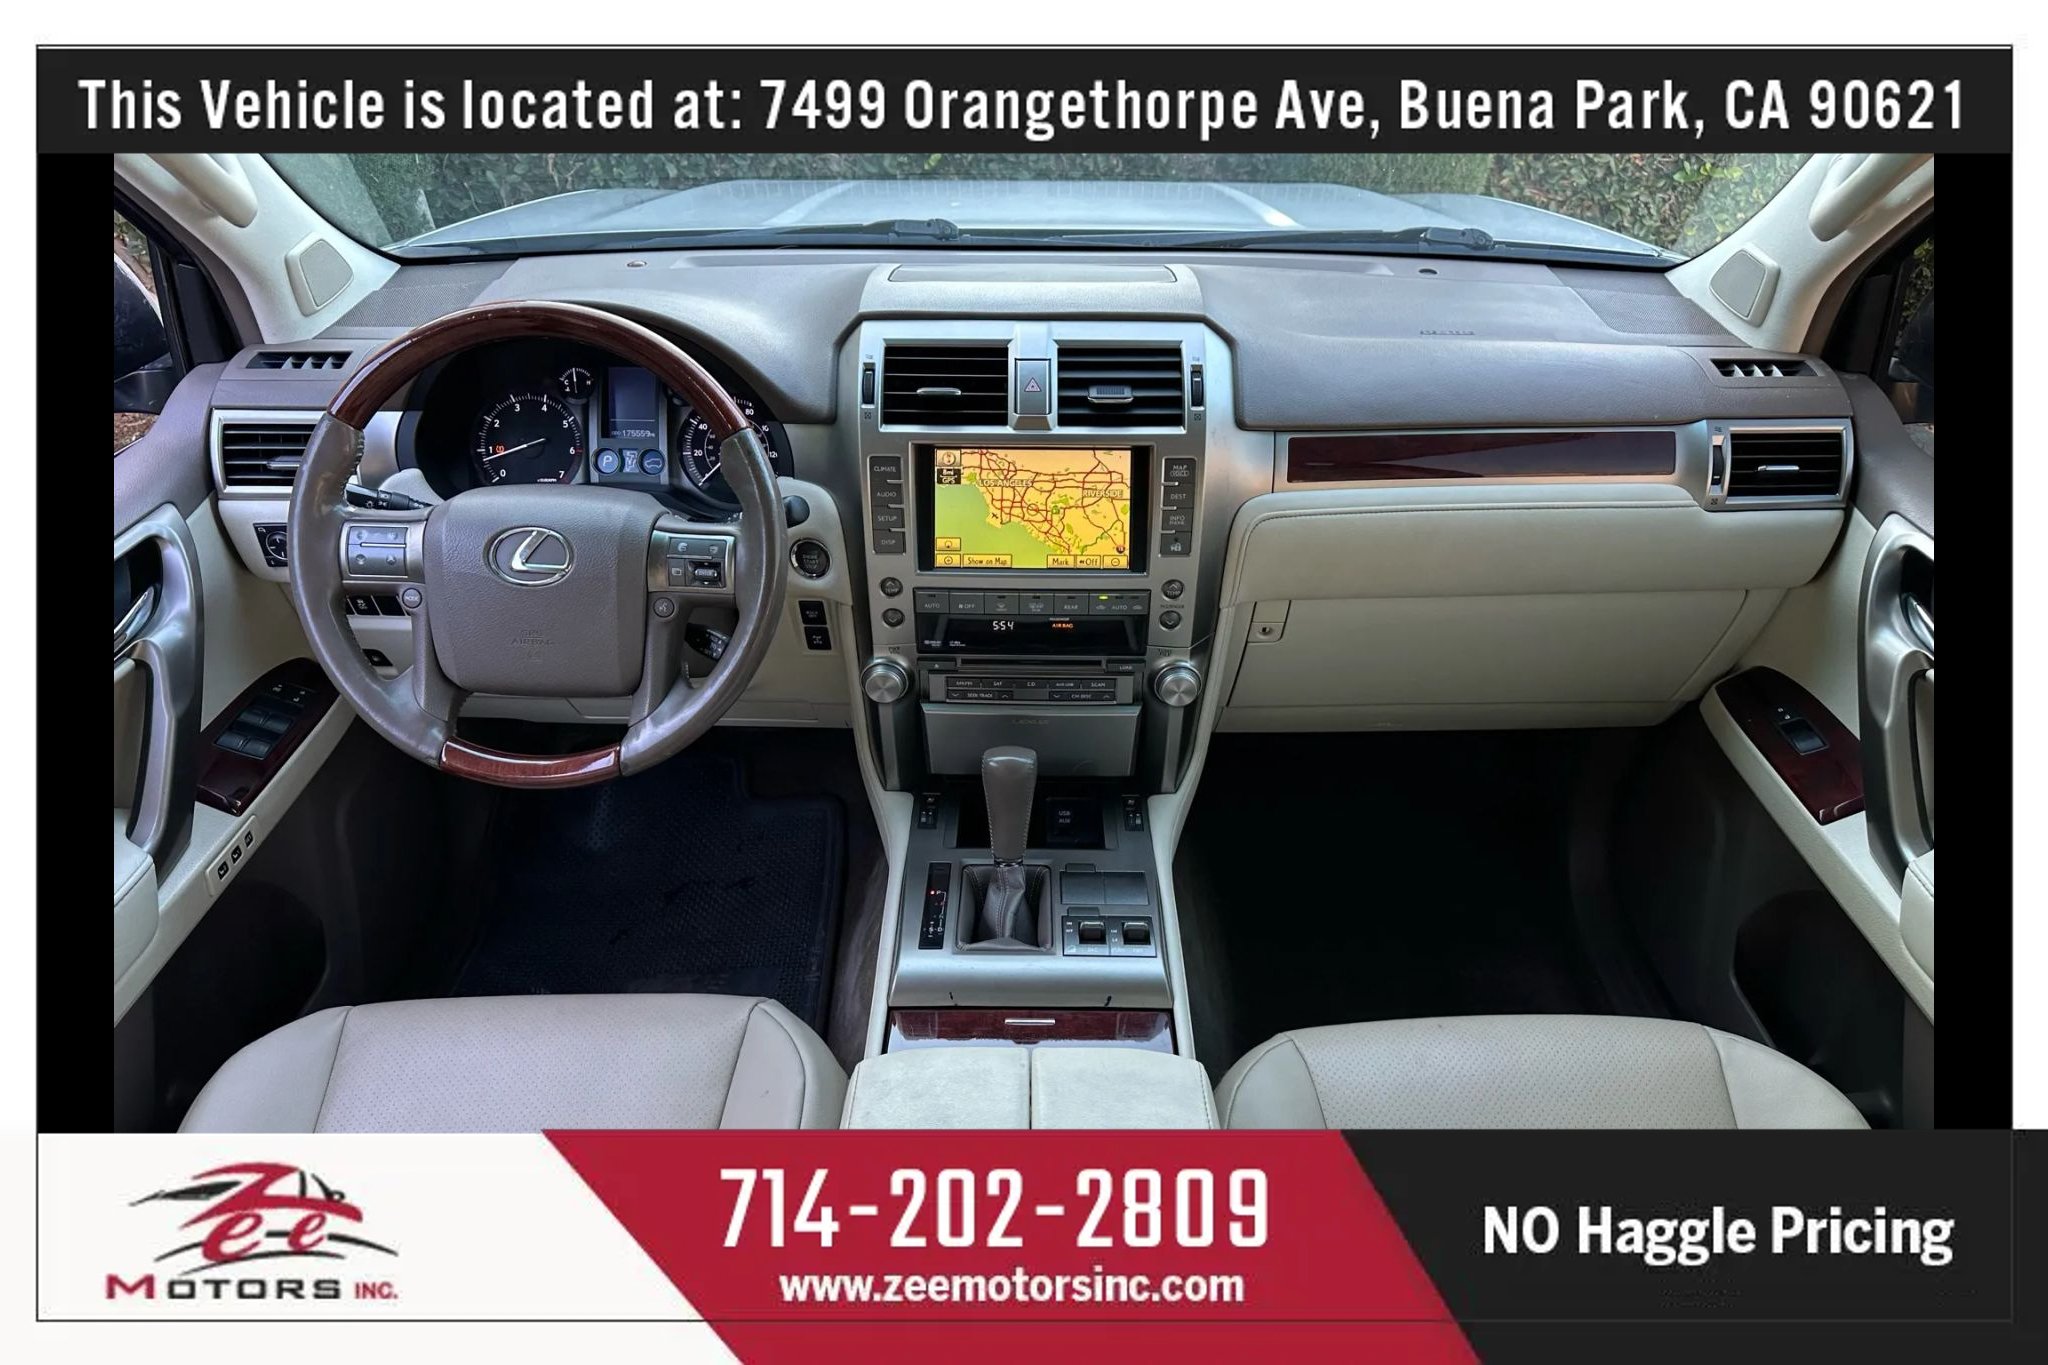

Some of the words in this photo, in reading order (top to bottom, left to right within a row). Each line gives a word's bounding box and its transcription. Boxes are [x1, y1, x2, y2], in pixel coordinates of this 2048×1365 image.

[1082, 489, 1123, 498] RIVERSIDE
[967, 557, 984, 566] Show
[995, 557, 1008, 568] Map
[1052, 557, 1070, 566] Mark
[1085, 558, 1098, 567] Off
